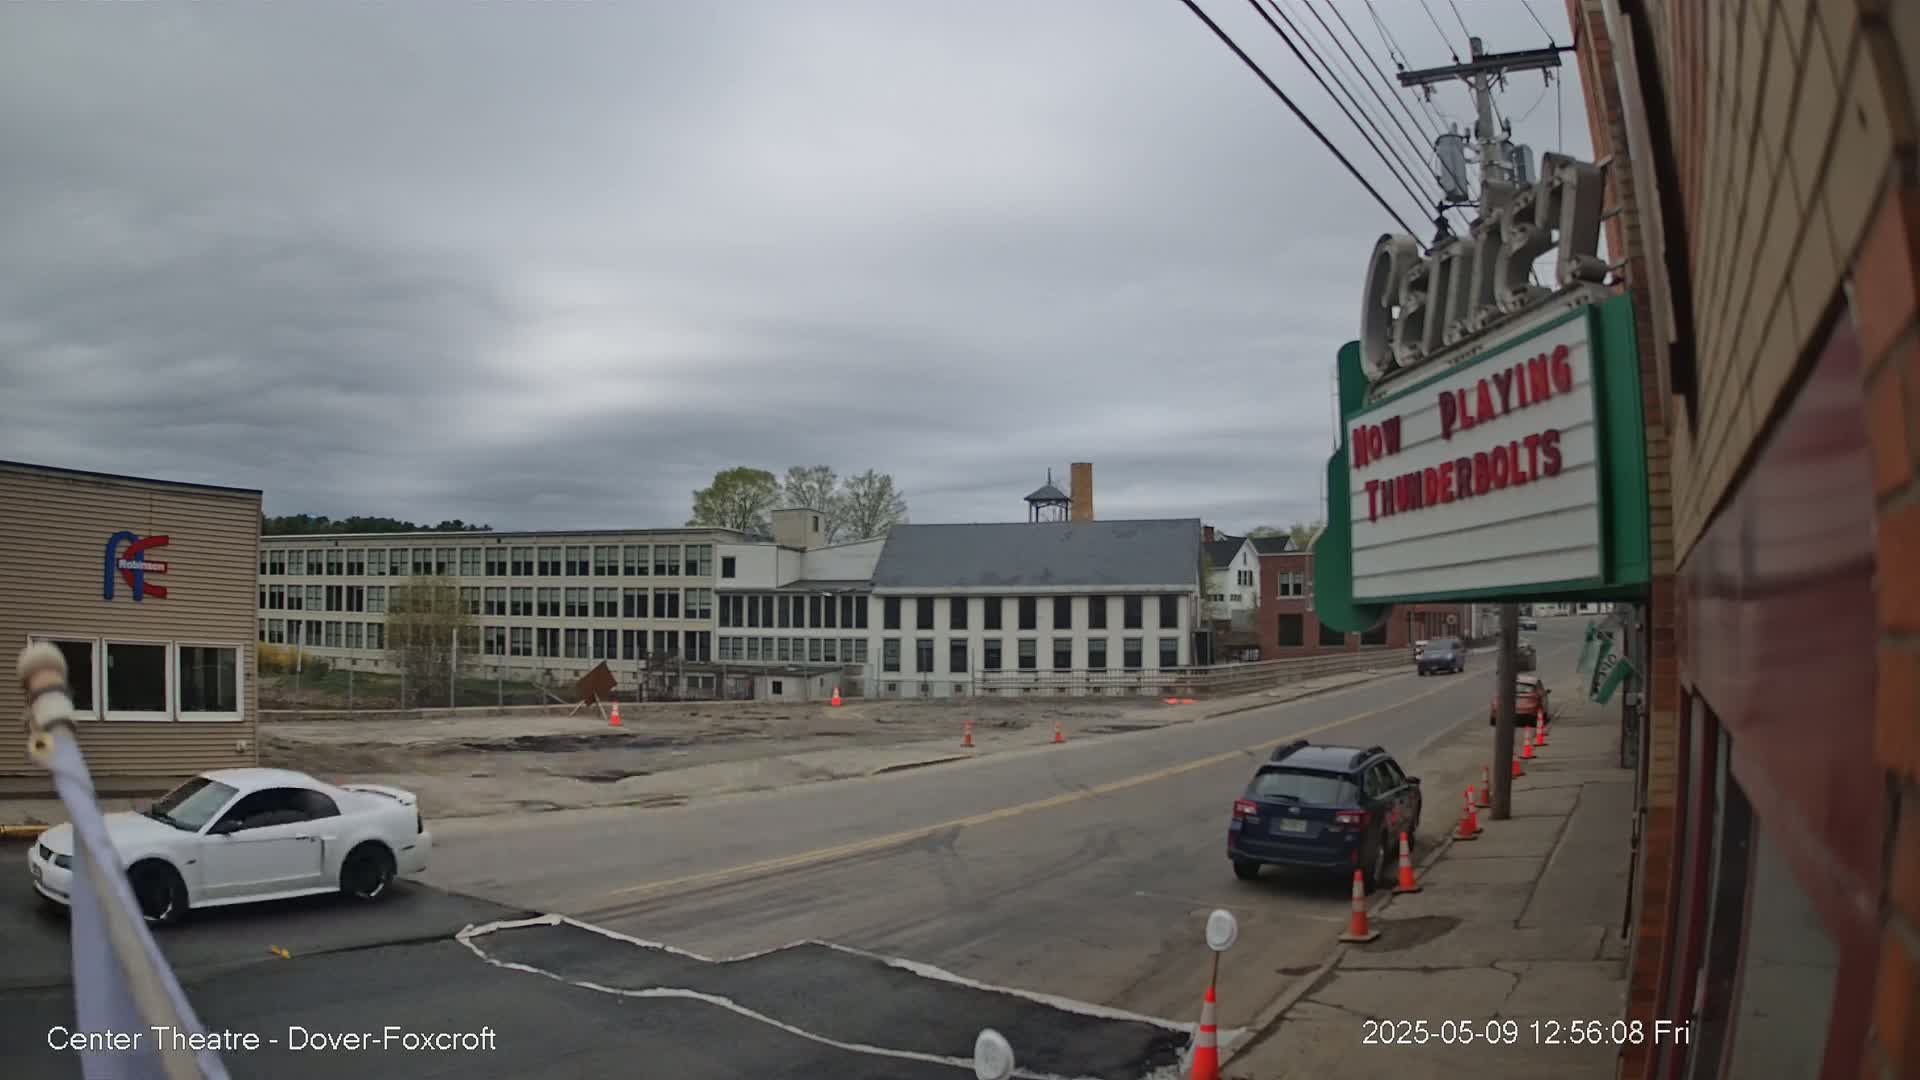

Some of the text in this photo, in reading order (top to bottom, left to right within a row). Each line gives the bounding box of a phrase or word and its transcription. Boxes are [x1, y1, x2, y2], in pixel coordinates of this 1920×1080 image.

[1352, 344, 1573, 470] NOW PLAYING
[1365, 429, 1562, 522] THUNDERBOLTS
